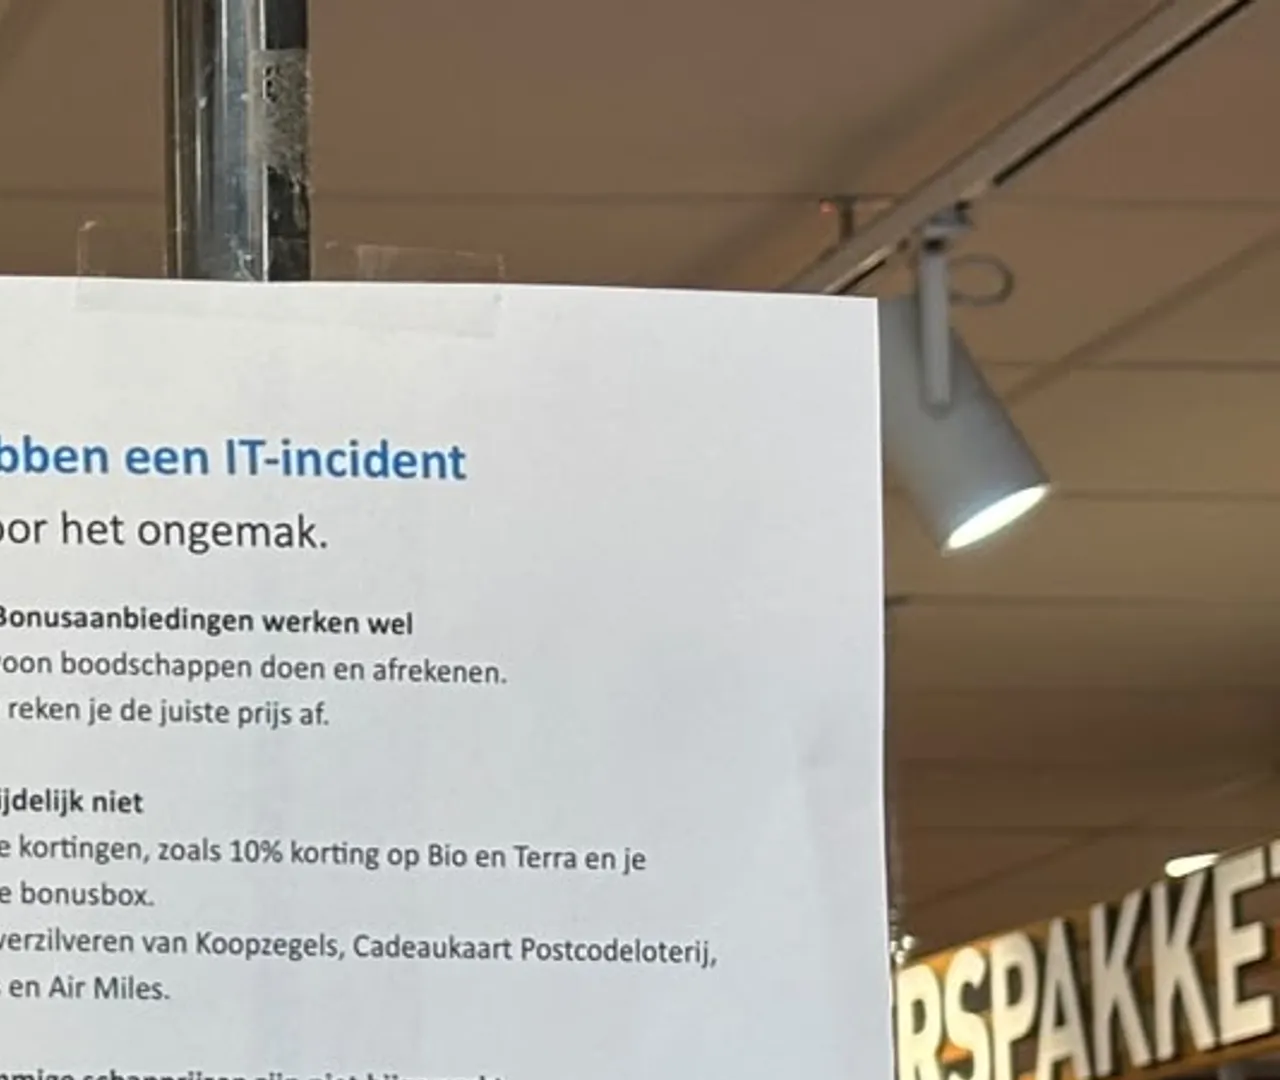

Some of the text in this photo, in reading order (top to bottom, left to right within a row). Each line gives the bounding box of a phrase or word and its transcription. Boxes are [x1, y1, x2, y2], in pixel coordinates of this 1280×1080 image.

[124, 446, 210, 476] een
[225, 437, 468, 481] IT-incident
[60, 509, 126, 546] het
[137, 512, 328, 556] ongemak.
[261, 608, 360, 635] werken
[367, 611, 413, 636] wel
[60, 649, 253, 683] boodschappen
[260, 653, 326, 681] doen
[333, 662, 365, 681] en
[372, 656, 507, 684] afrekenen.
[8, 695, 81, 721] reken
[87, 697, 113, 727] je
[119, 696, 153, 722] de
[158, 698, 231, 728] juiste
[237, 700, 293, 731] prijs
[299, 700, 330, 726] af.
[91, 789, 145, 815] niet
[19, 833, 150, 866] kortingen,
[157, 837, 222, 863] zoals
[229, 839, 284, 864] 10%
[290, 839, 380, 871] korting
[386, 847, 420, 872] op
[428, 843, 468, 868] Bio
[475, 849, 506, 868] en
[512, 844, 578, 870] Terra
[584, 851, 617, 870] en
[622, 847, 647, 876] je
[20, 880, 155, 907] bonusbox.
[141, 935, 188, 954] van
[195, 931, 345, 962] Koopzegels,
[353, 933, 513, 961] Cadeaukaart
[521, 937, 718, 970] Postcodeloterij,
[8, 979, 41, 999] en
[48, 975, 87, 999] Air
[93, 974, 171, 1001] Miles.
